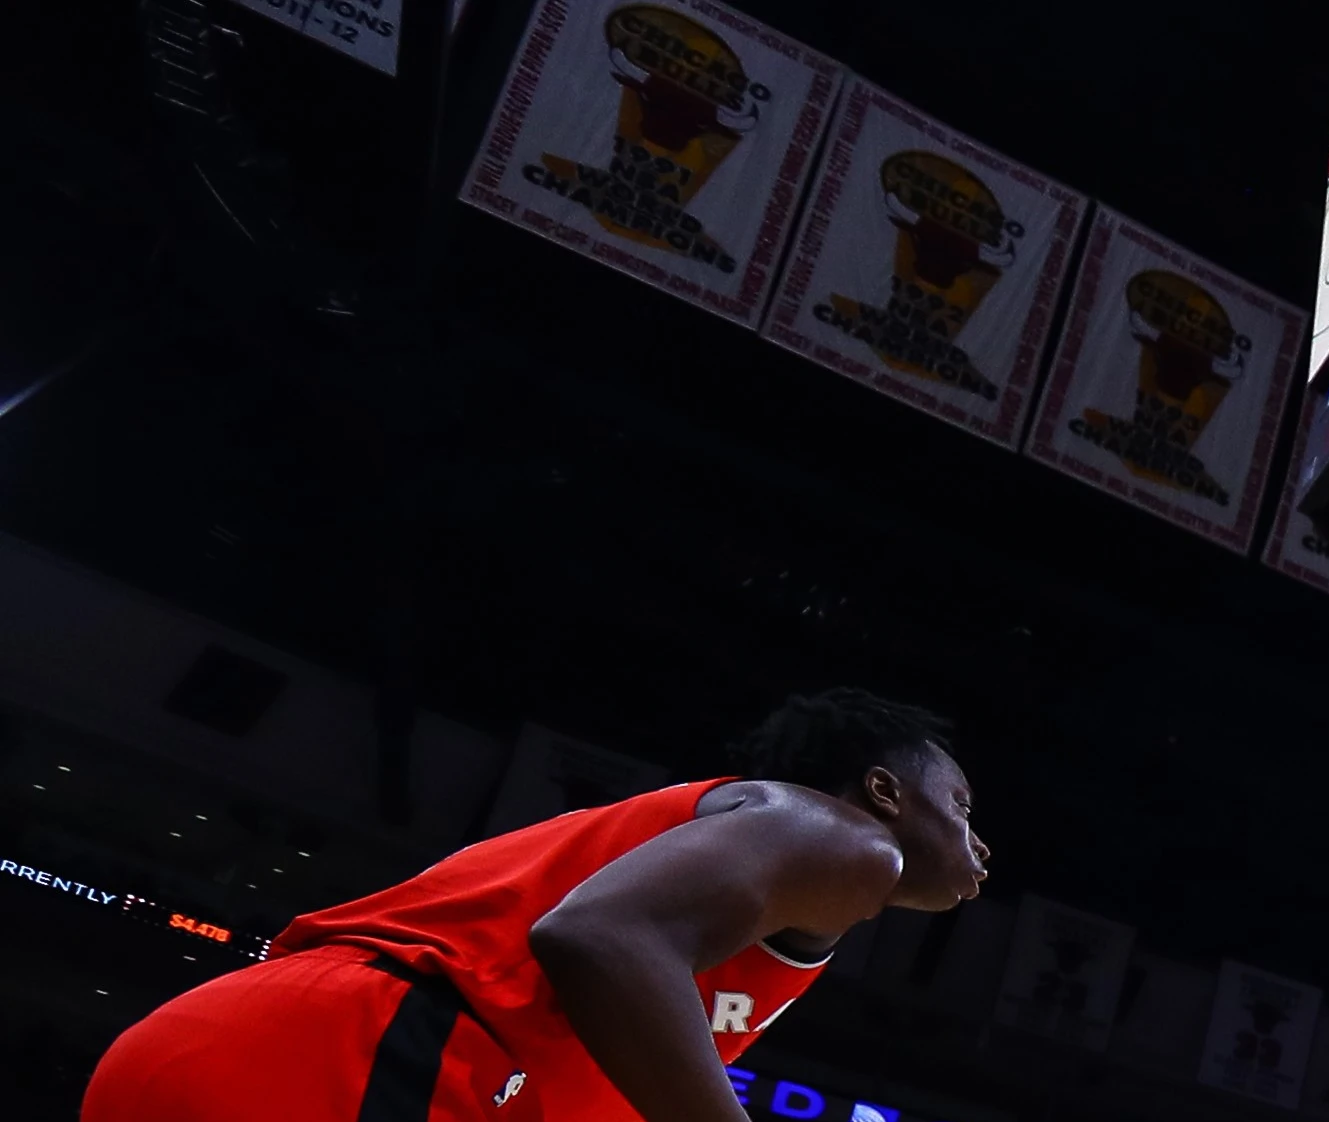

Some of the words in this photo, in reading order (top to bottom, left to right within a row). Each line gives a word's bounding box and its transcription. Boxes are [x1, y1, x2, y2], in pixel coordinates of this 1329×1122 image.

[331, 20, 358, 44] 12
[619, 12, 770, 101] CHICAGO
[637, 46, 744, 111] BULLS
[610, 157, 682, 203] NBA
[614, 136, 691, 185] 1991
[521, 164, 737, 274] CHAMPIONS
[576, 163, 703, 235] WORLD
[894, 160, 1025, 239] CHICAGO
[812, 303, 998, 401] CHAMPIONS
